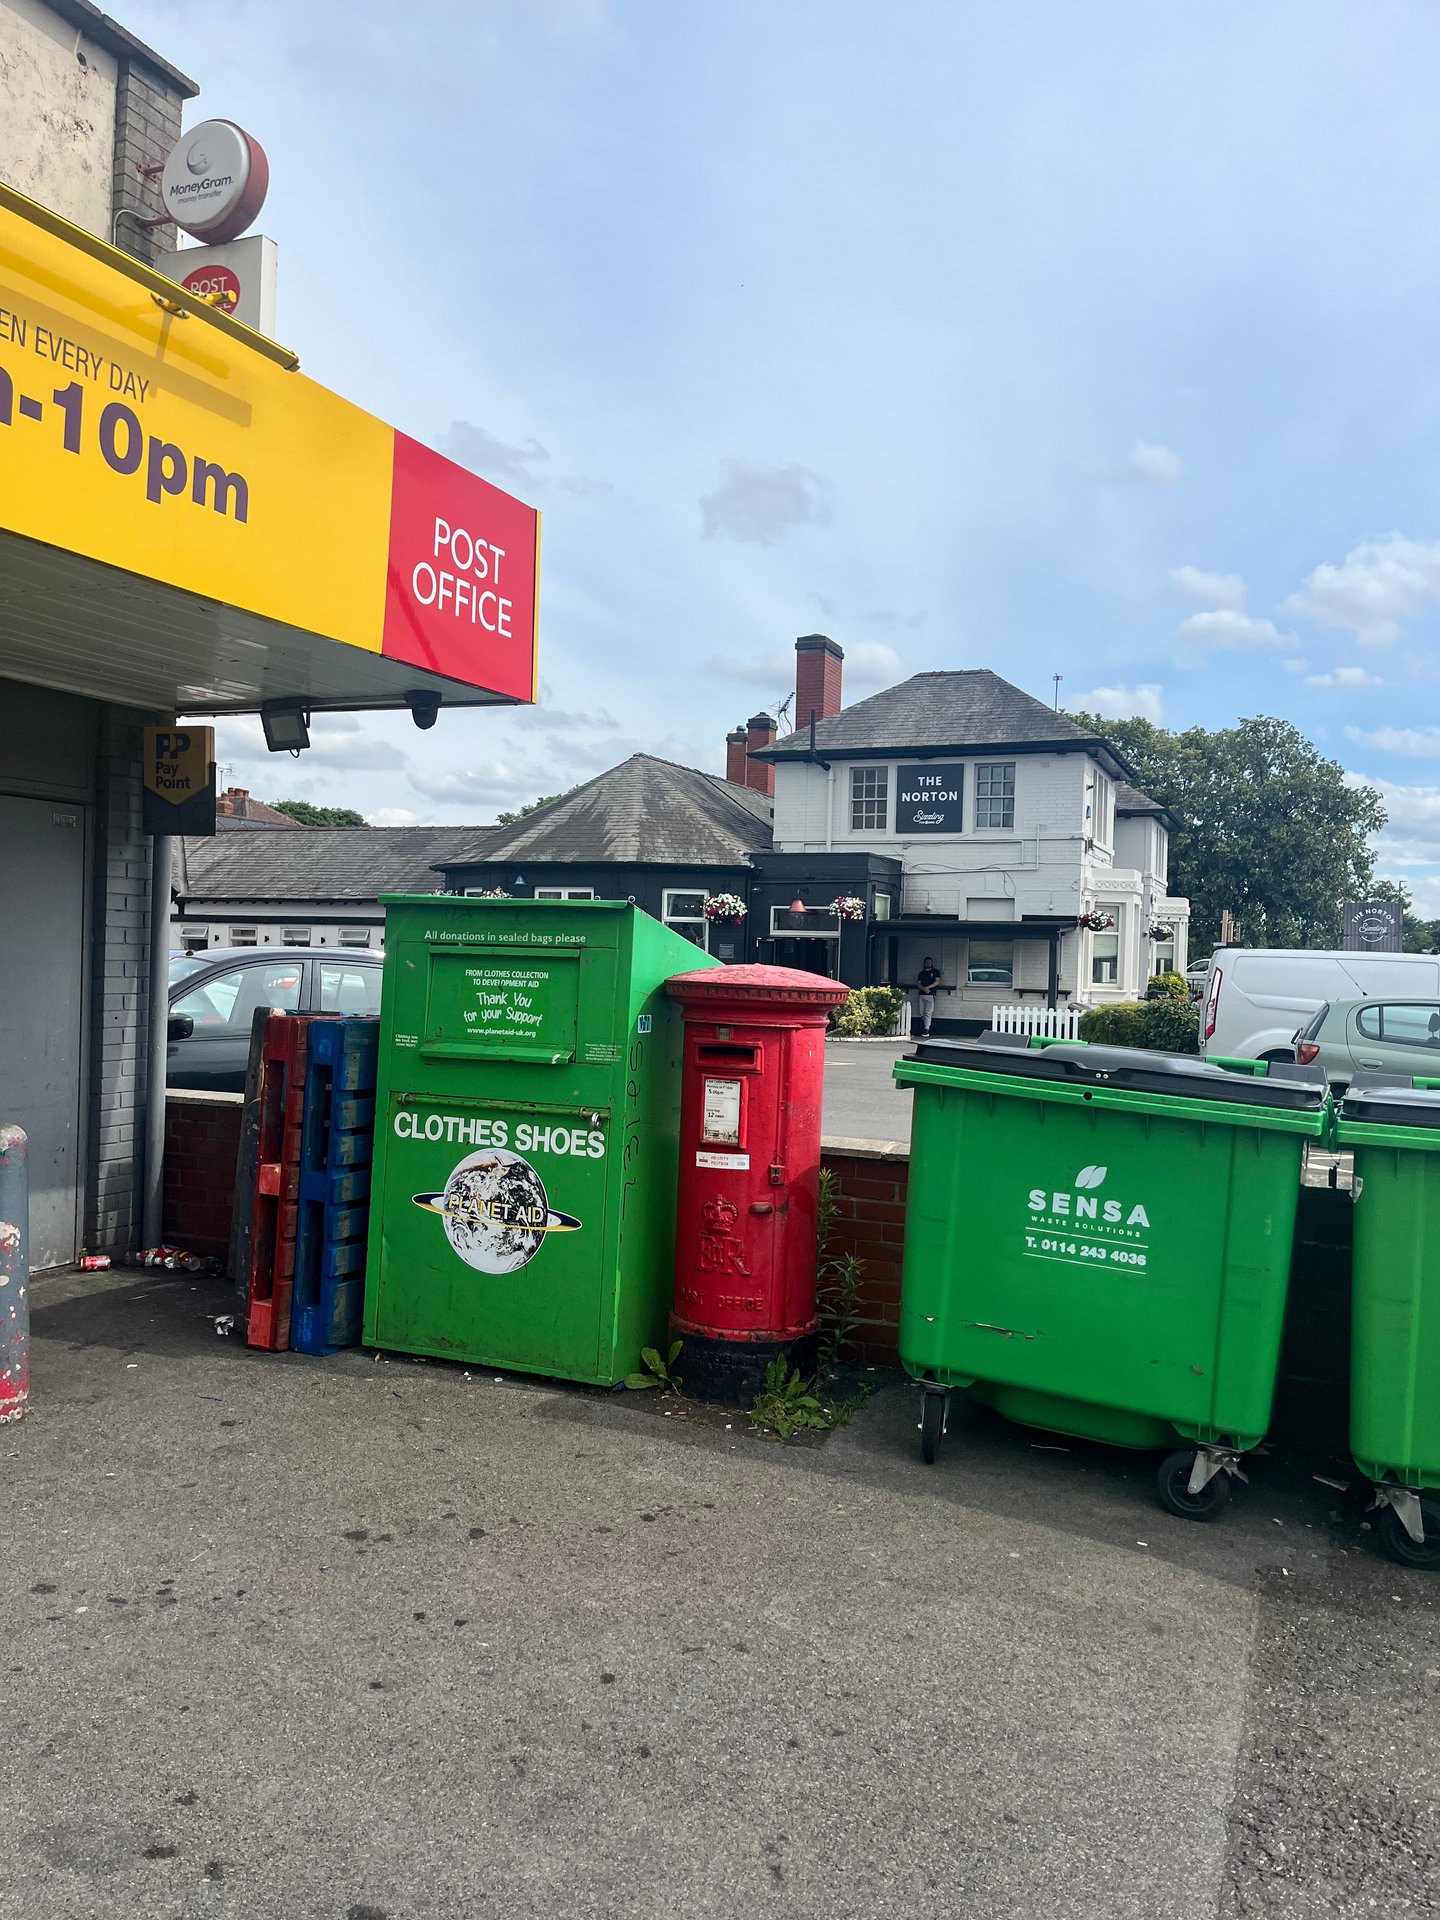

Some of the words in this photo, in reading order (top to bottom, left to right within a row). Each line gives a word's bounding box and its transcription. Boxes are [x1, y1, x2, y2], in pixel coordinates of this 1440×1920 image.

[170, 175, 232, 197] MoneyGram
[177, 194, 197, 205] money
[197, 189, 223, 201] transfer
[190, 276, 228, 294] POST
[35, 326, 103, 381] EVERY
[109, 362, 149, 404] DAY
[0, 366, 249, 524] -10pm
[434, 516, 505, 585] POST
[412, 561, 512, 639] OFFICE
[156, 761, 178, 778] Pay
[156, 774, 191, 790] Point
[918, 776, 942, 787] THE
[902, 791, 958, 802] NORTON
[1351, 911, 1365, 924] THE
[1365, 908, 1396, 925] NORTON
[424, 930, 437, 940] All
[440, 931, 485, 942] donations
[487, 932, 496, 942] in
[498, 932, 528, 943] sealed
[531, 933, 553, 945] bags
[555, 933, 586, 945] please
[465, 969, 483, 978] FROM
[484, 970, 510, 978] CLOTHES
[512, 970, 549, 979] COLLECTION
[473, 978, 481, 986] TO
[482, 979, 526, 988] DEVELOPMENT
[528, 980, 539, 988] AID
[476, 991, 508, 1006] Thank
[514, 992, 532, 1009] You
[463, 1009, 477, 1023] for
[481, 1008, 502, 1023] your
[505, 1006, 543, 1027] Support
[466, 1027, 536, 1038] www.planetaid-uk.org
[394, 1111, 508, 1148] CLOTHES
[515, 1123, 605, 1159] SHOES
[448, 1193, 513, 1220] PLANET
[515, 1204, 545, 1223] AID
[1027, 1189, 1150, 1228] SENSA
[1031, 1215, 1067, 1227] WASTE
[1074, 1221, 1141, 1238] SOLUTIONS
[1025, 1236, 1038, 1249] T.
[1041, 1239, 1076, 1255] 0114
[1079, 1245, 1107, 1260] 243
[1110, 1250, 1147, 1266] 4036
[717, 1294, 763, 1312] OFFICE
